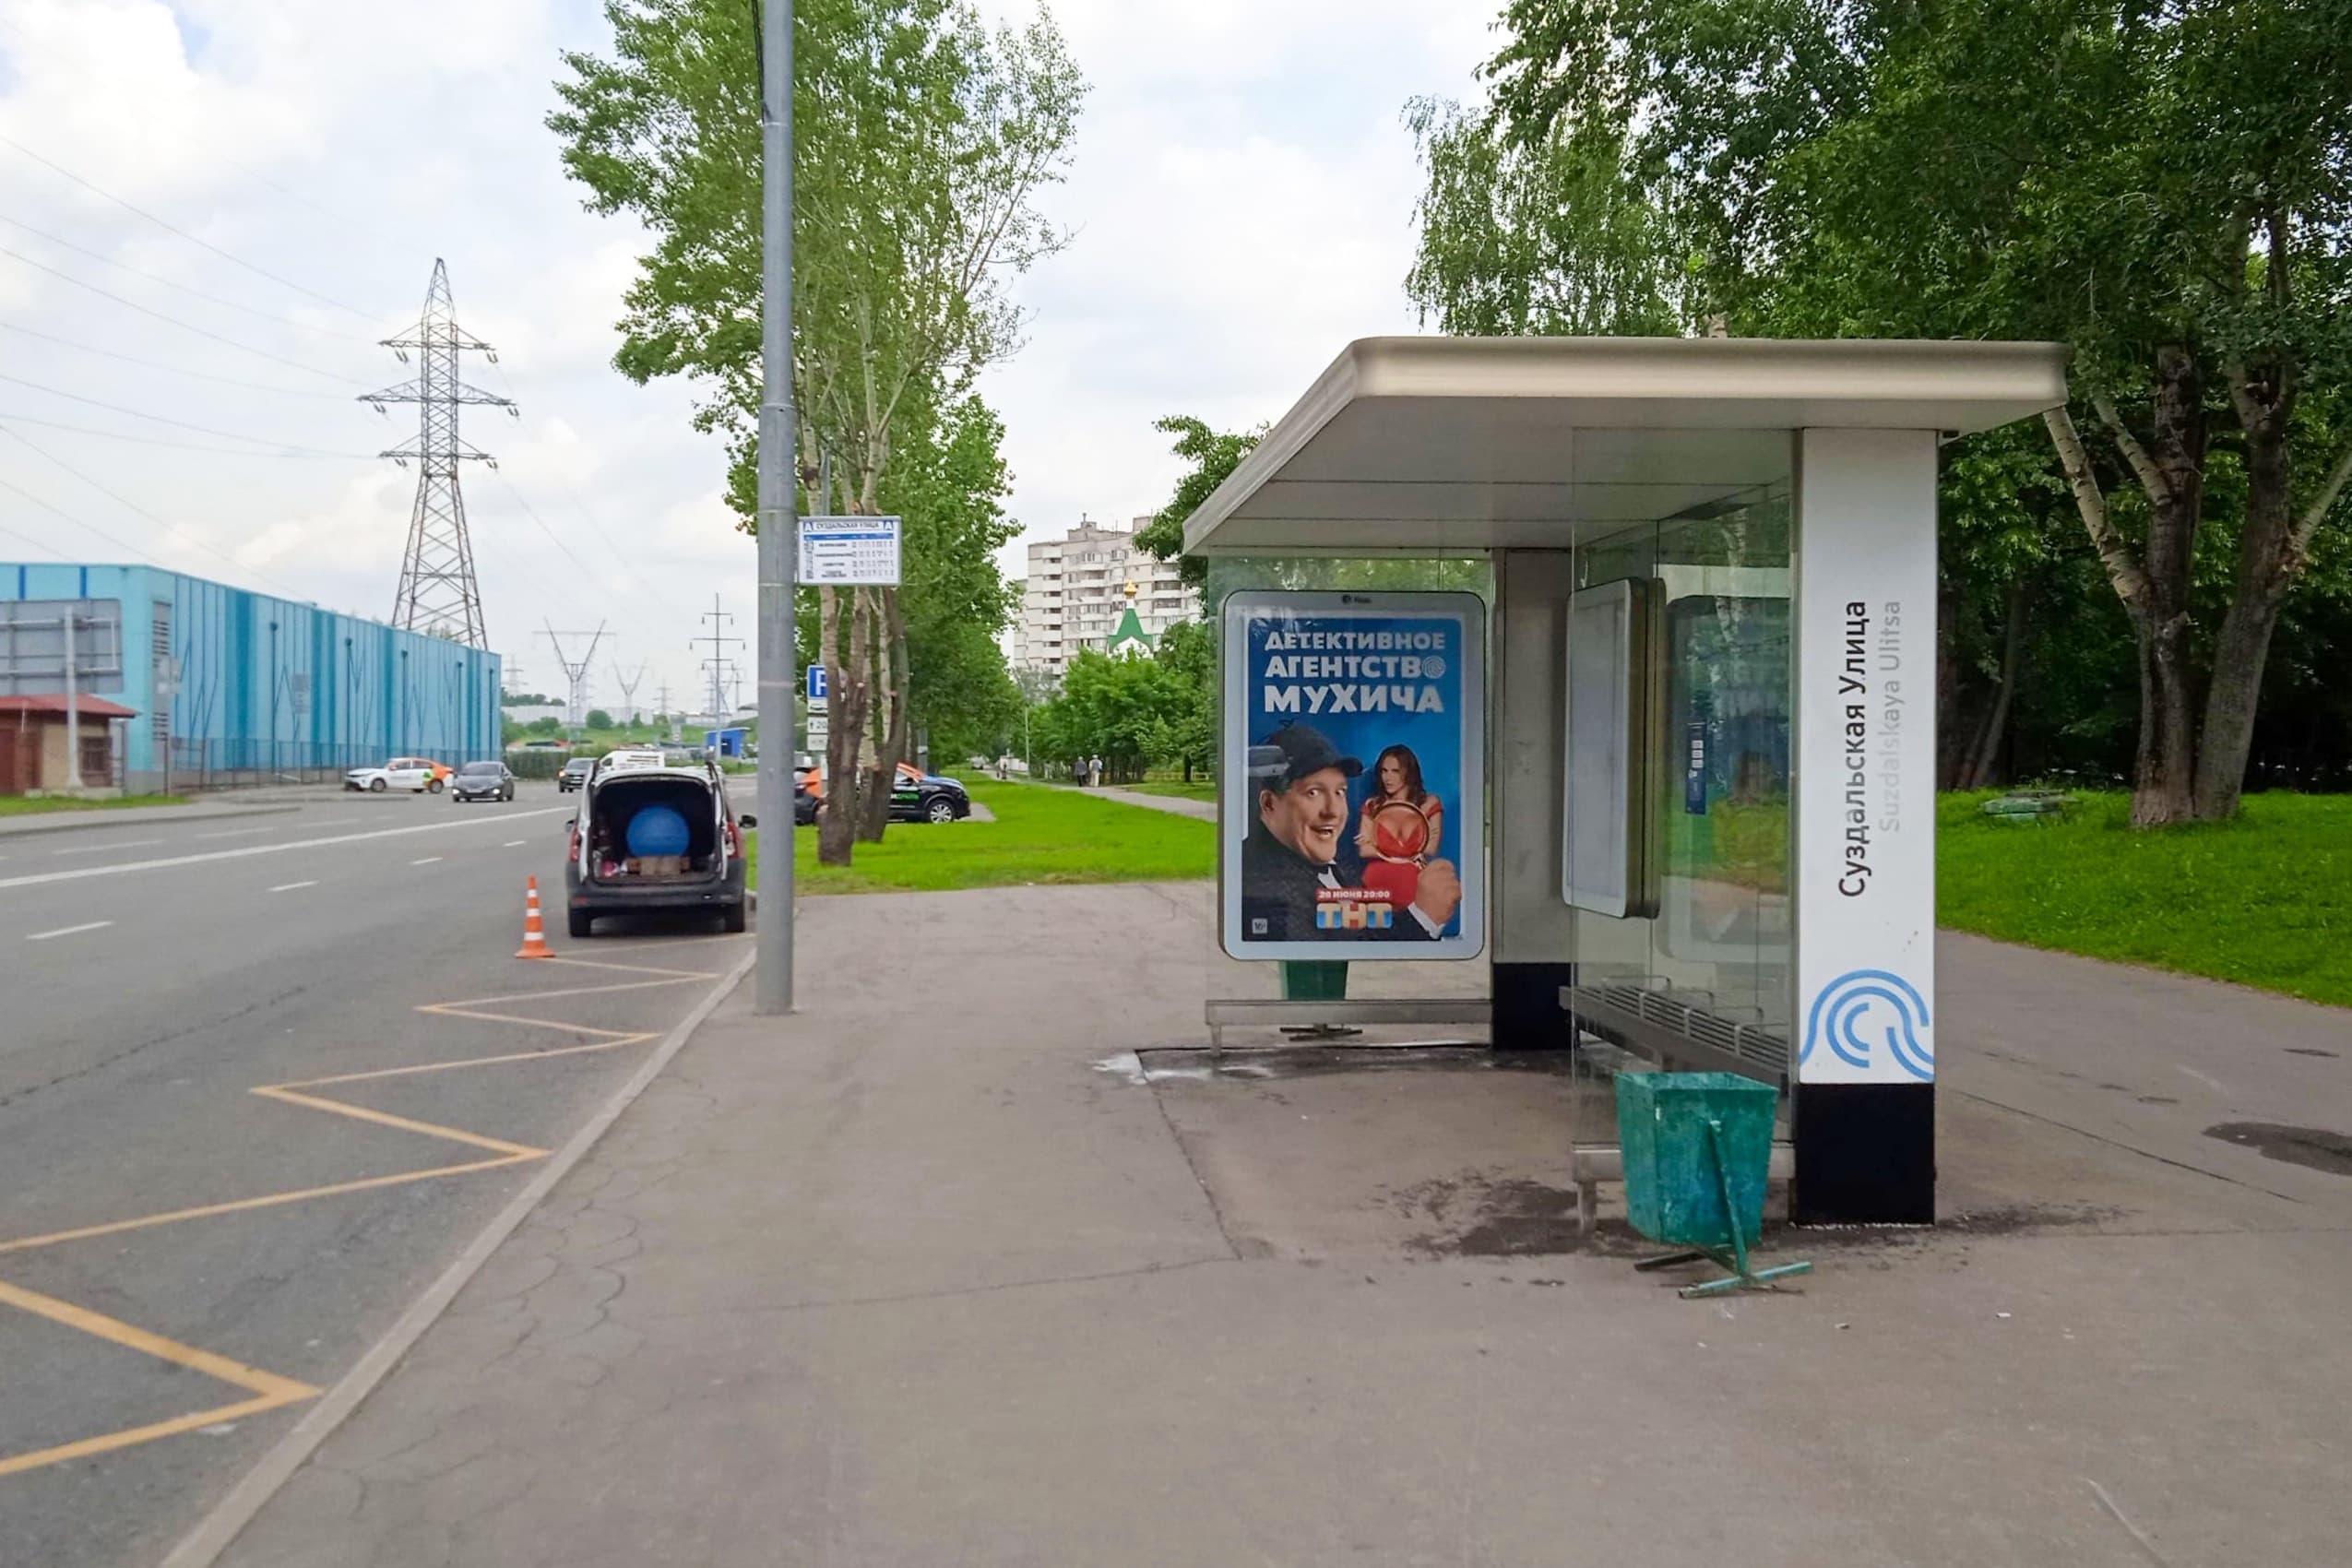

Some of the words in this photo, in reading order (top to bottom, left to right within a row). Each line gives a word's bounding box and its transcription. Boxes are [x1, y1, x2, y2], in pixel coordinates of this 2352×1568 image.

[1264, 631, 1446, 651] ДЕТЕКТИВНОЕ
[1838, 600, 1871, 695] Улица
[1878, 600, 1901, 671] Ulitsa
[1264, 655, 1447, 680] АГЕНТСТВО
[1264, 683, 1445, 715] МУХИЧА
[1878, 680, 1906, 833] Suzdalskaya
[1838, 704, 1871, 897] Суздальская
[1316, 903, 1393, 930] ТНТ
